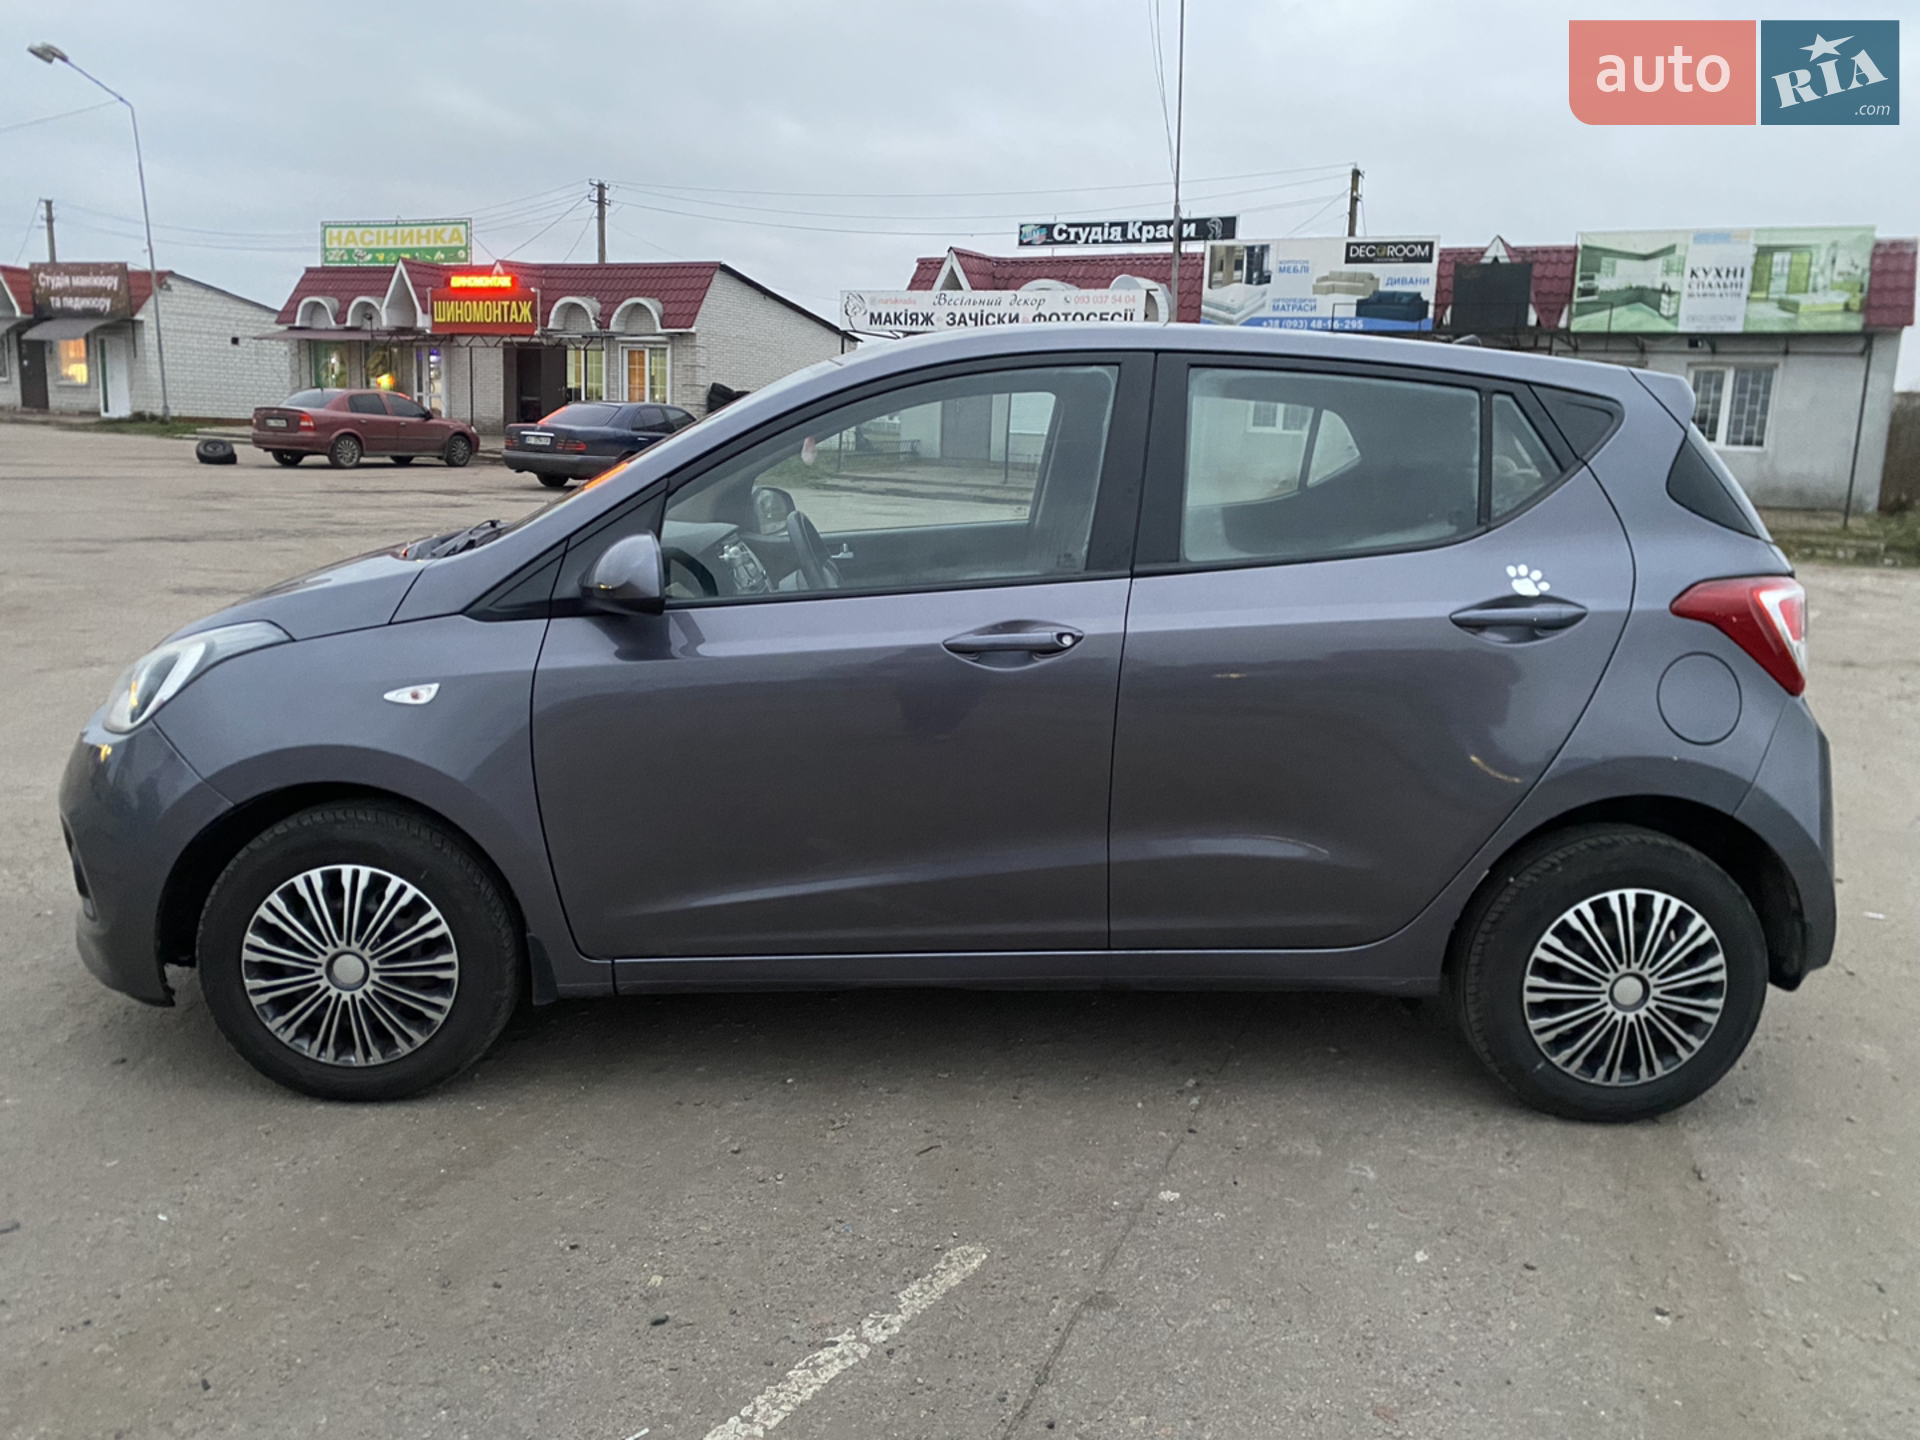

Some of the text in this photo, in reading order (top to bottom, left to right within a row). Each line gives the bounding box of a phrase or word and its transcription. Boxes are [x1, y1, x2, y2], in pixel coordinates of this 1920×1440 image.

[327, 227, 465, 247] НАСІНИНКА
[1052, 223, 1122, 244] Студія
[1279, 265, 1309, 274] МЕБЛІ
[1690, 266, 1745, 279] КУХНІ
[38, 272, 70, 290] Студія
[1385, 276, 1430, 286] ДИВАНИ
[1688, 281, 1743, 290] СПАЛЬНІ
[932, 293, 1002, 307] Весільний
[1009, 294, 1046, 311] декор
[1074, 295, 1090, 305] 093
[1111, 295, 1123, 304] 54
[1125, 295, 1136, 304] 04
[434, 301, 533, 322] ШИНОМОНТАЖ
[1272, 303, 1317, 312] МАТРАСИ
[869, 309, 934, 326] МАКІЯЖ
[946, 310, 1019, 326] ЗАЧІСКИ
[1282, 320, 1308, 330] (093)
